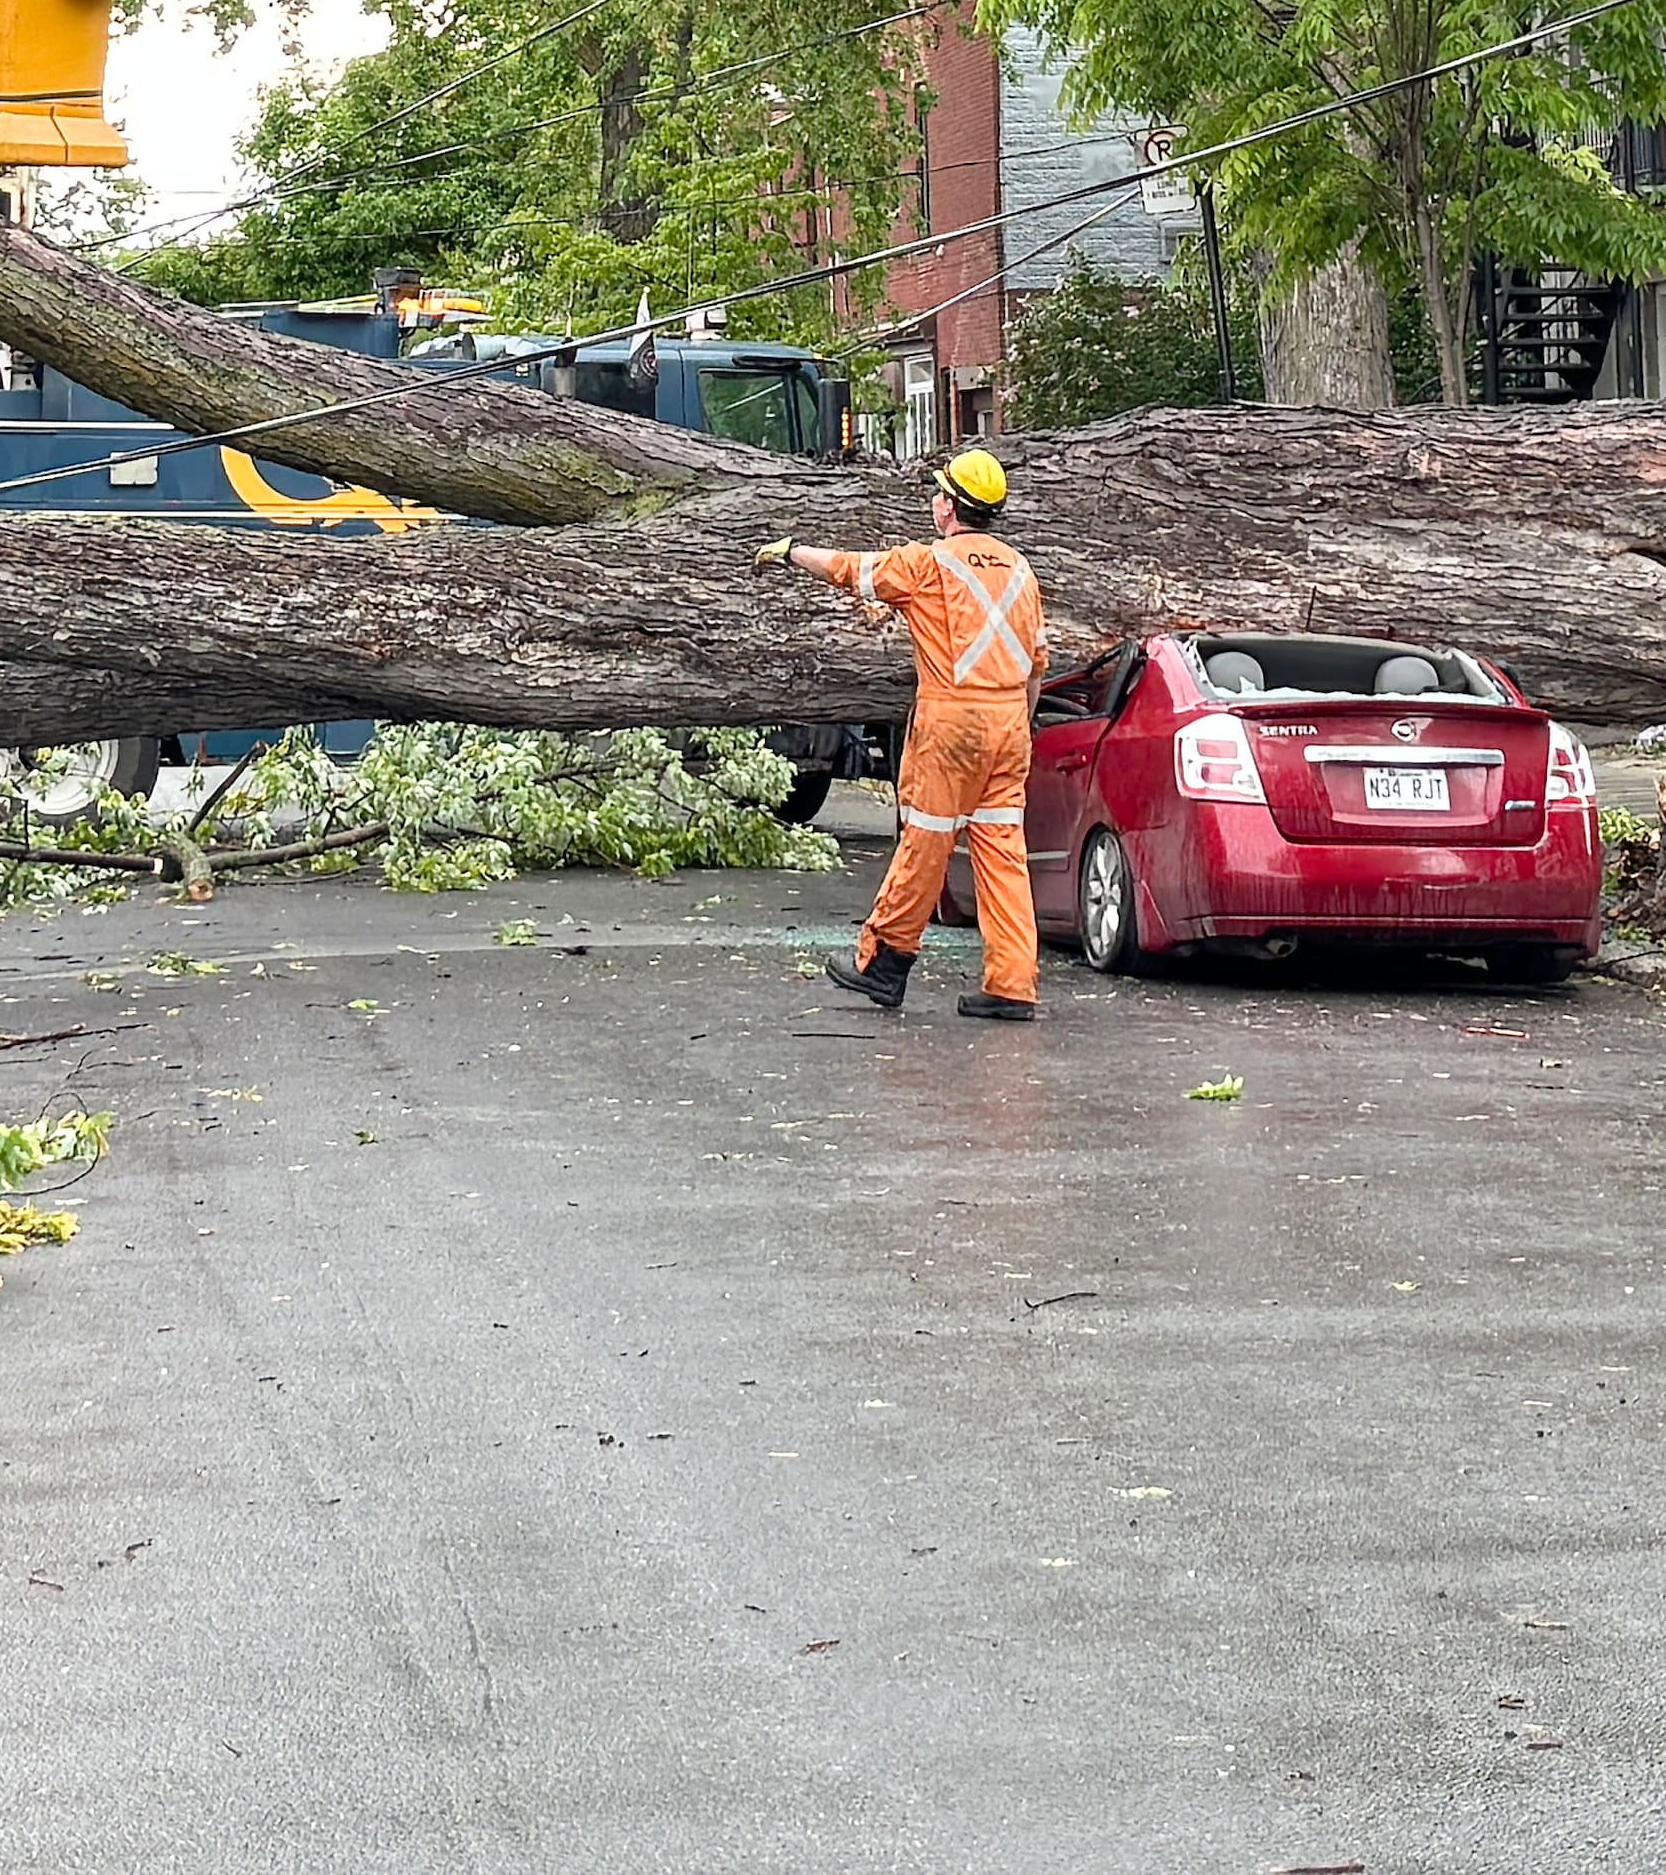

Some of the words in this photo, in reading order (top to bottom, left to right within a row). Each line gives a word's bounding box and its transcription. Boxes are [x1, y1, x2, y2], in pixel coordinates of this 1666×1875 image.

[1259, 724, 1318, 736] SENTRA
[1370, 777, 1401, 798] N34
[1412, 778, 1442, 800] RJT
